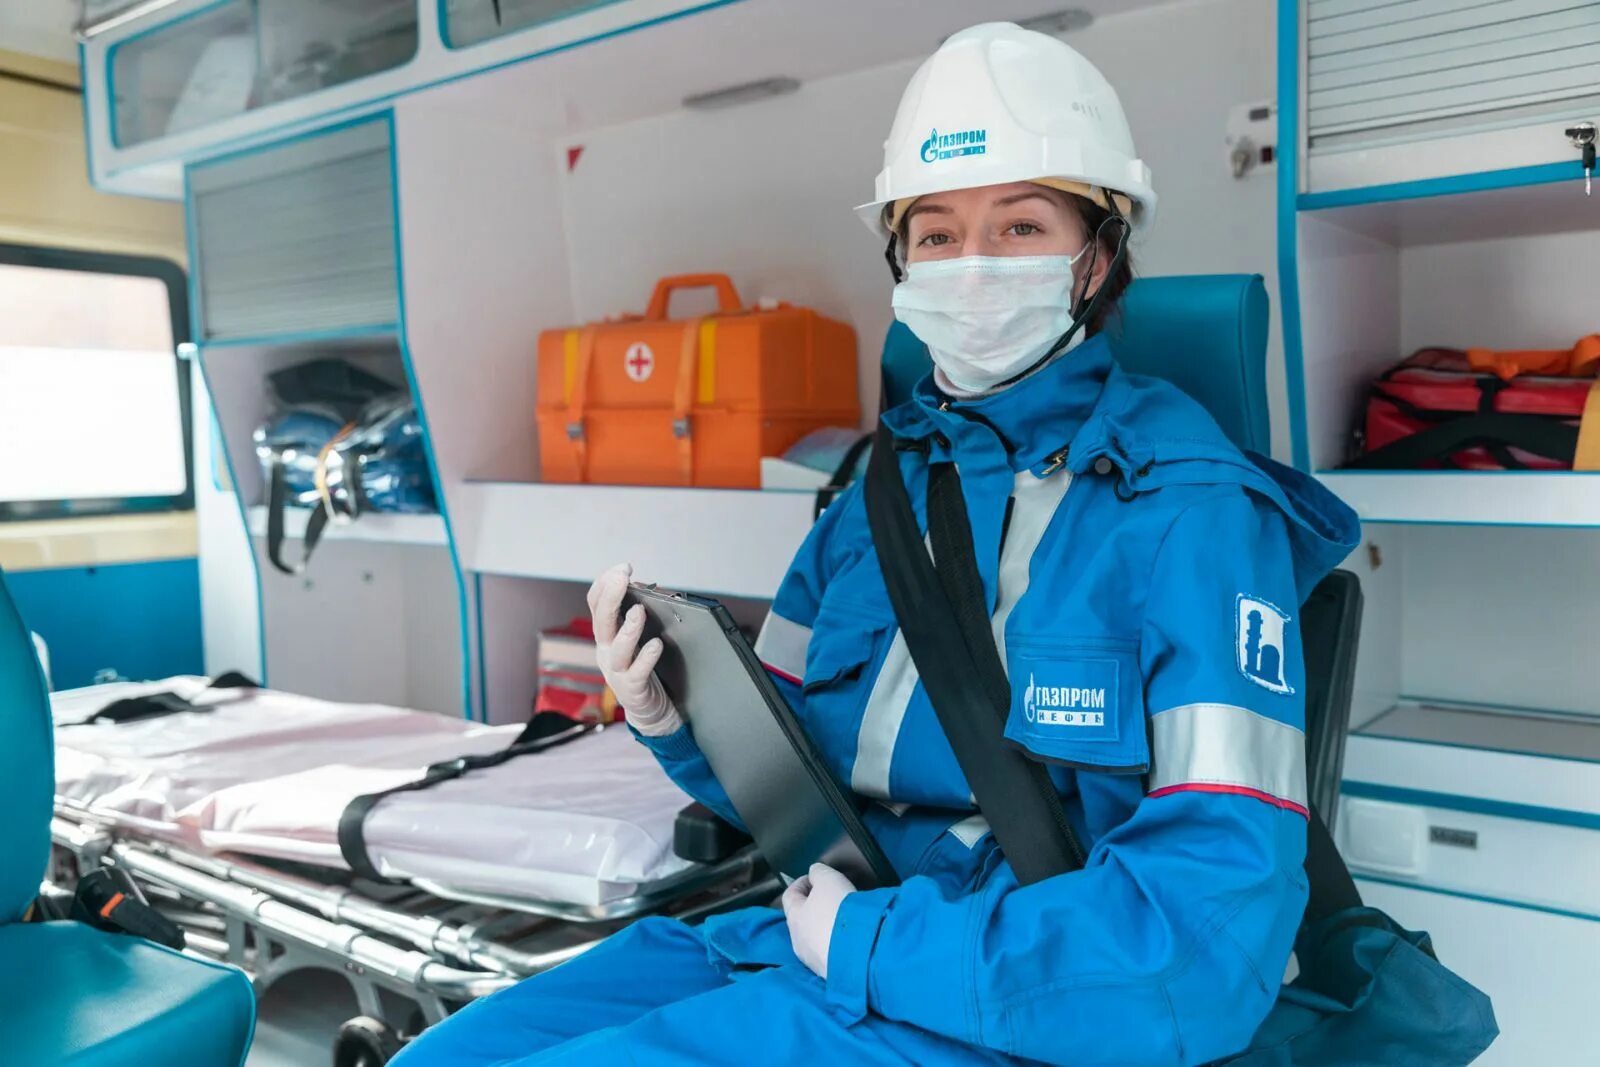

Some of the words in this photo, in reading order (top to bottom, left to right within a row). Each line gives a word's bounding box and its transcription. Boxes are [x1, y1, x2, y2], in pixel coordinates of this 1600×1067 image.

[938, 129, 986, 148] ГАЗПРОМ
[1036, 687, 1105, 708] ГАЗПРОМ
[1038, 711, 1102, 723] НЕФТЬ
